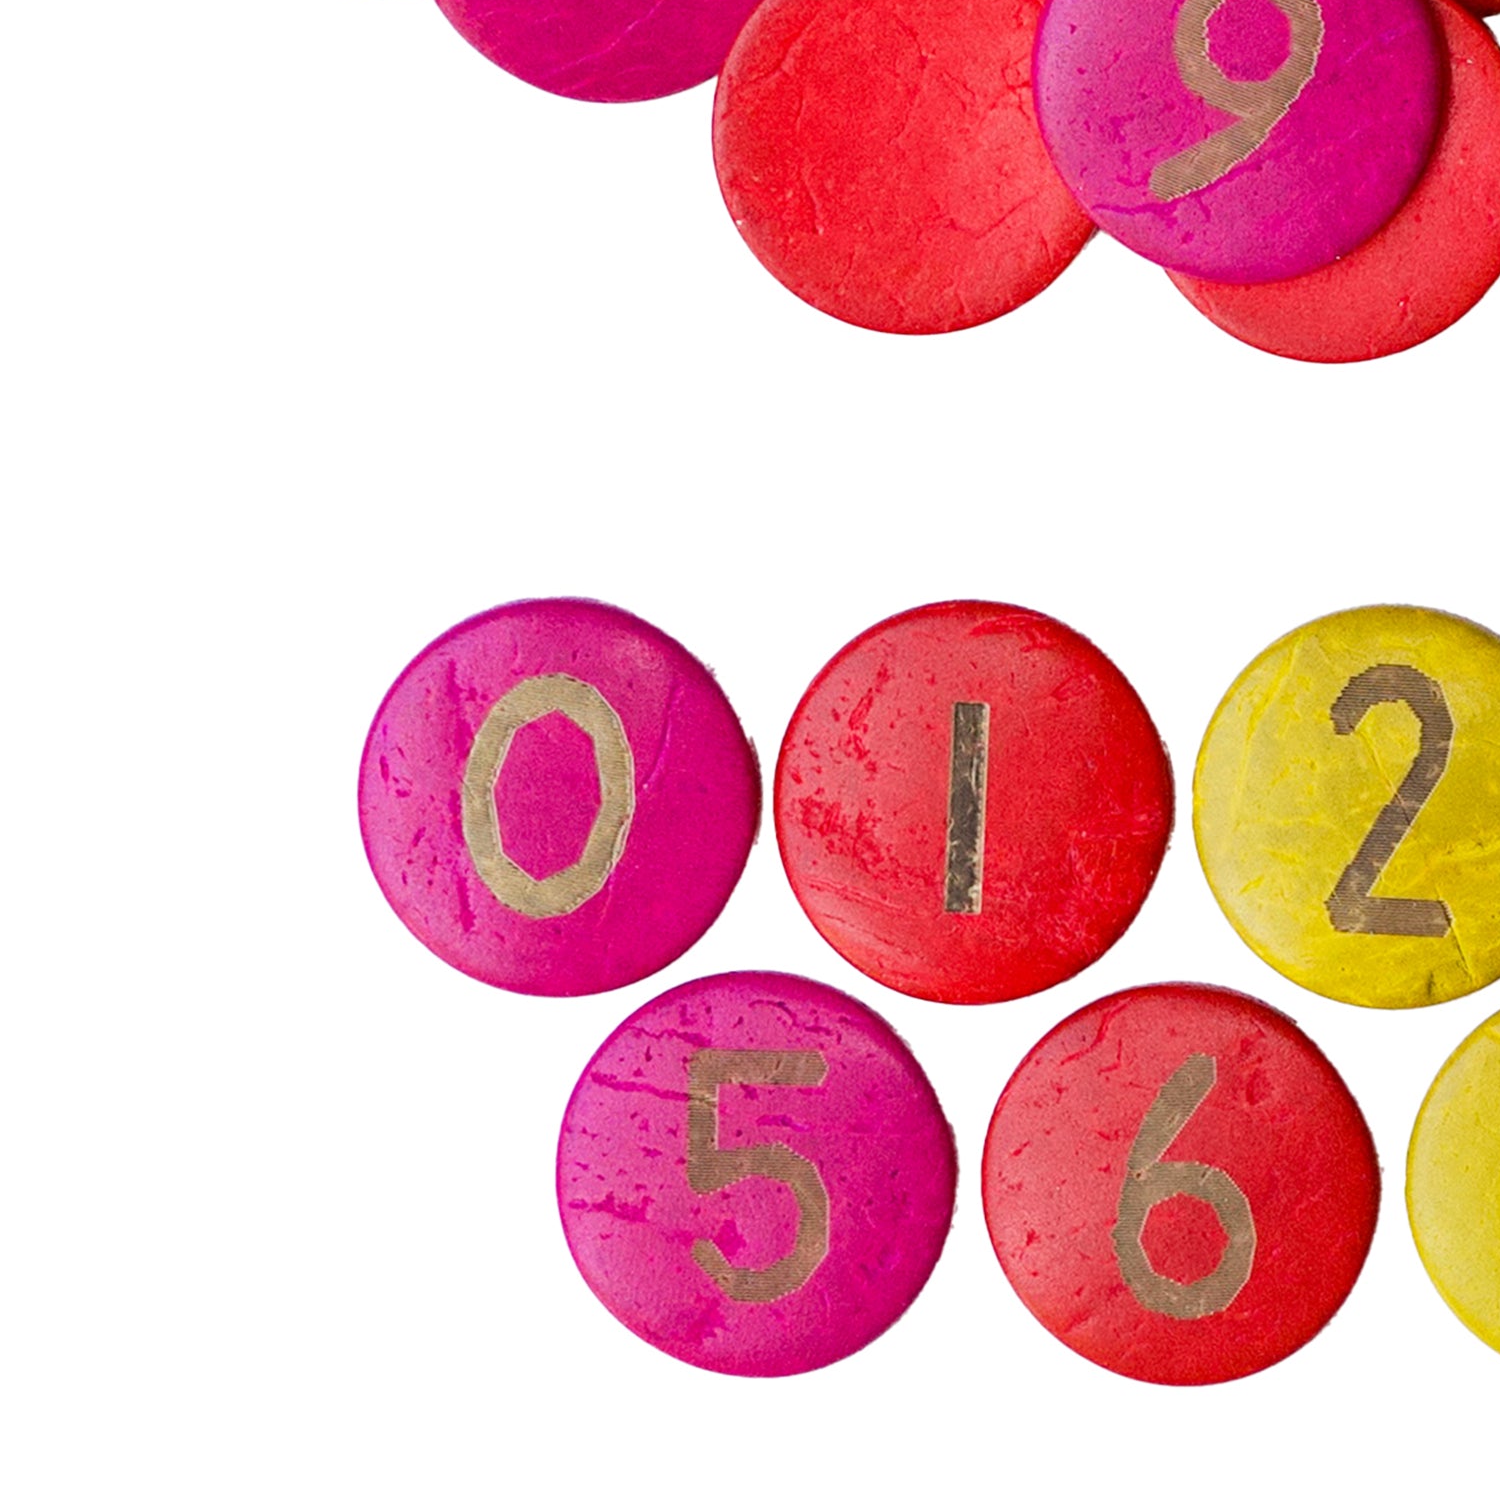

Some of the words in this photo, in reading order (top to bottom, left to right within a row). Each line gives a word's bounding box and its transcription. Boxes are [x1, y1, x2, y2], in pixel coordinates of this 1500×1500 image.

[461, 672, 636, 919] 0
[943, 700, 991, 916] 1
[1322, 662, 1456, 938] 2
[685, 1047, 830, 1303] 5
[1112, 1051, 1258, 1321] 6
